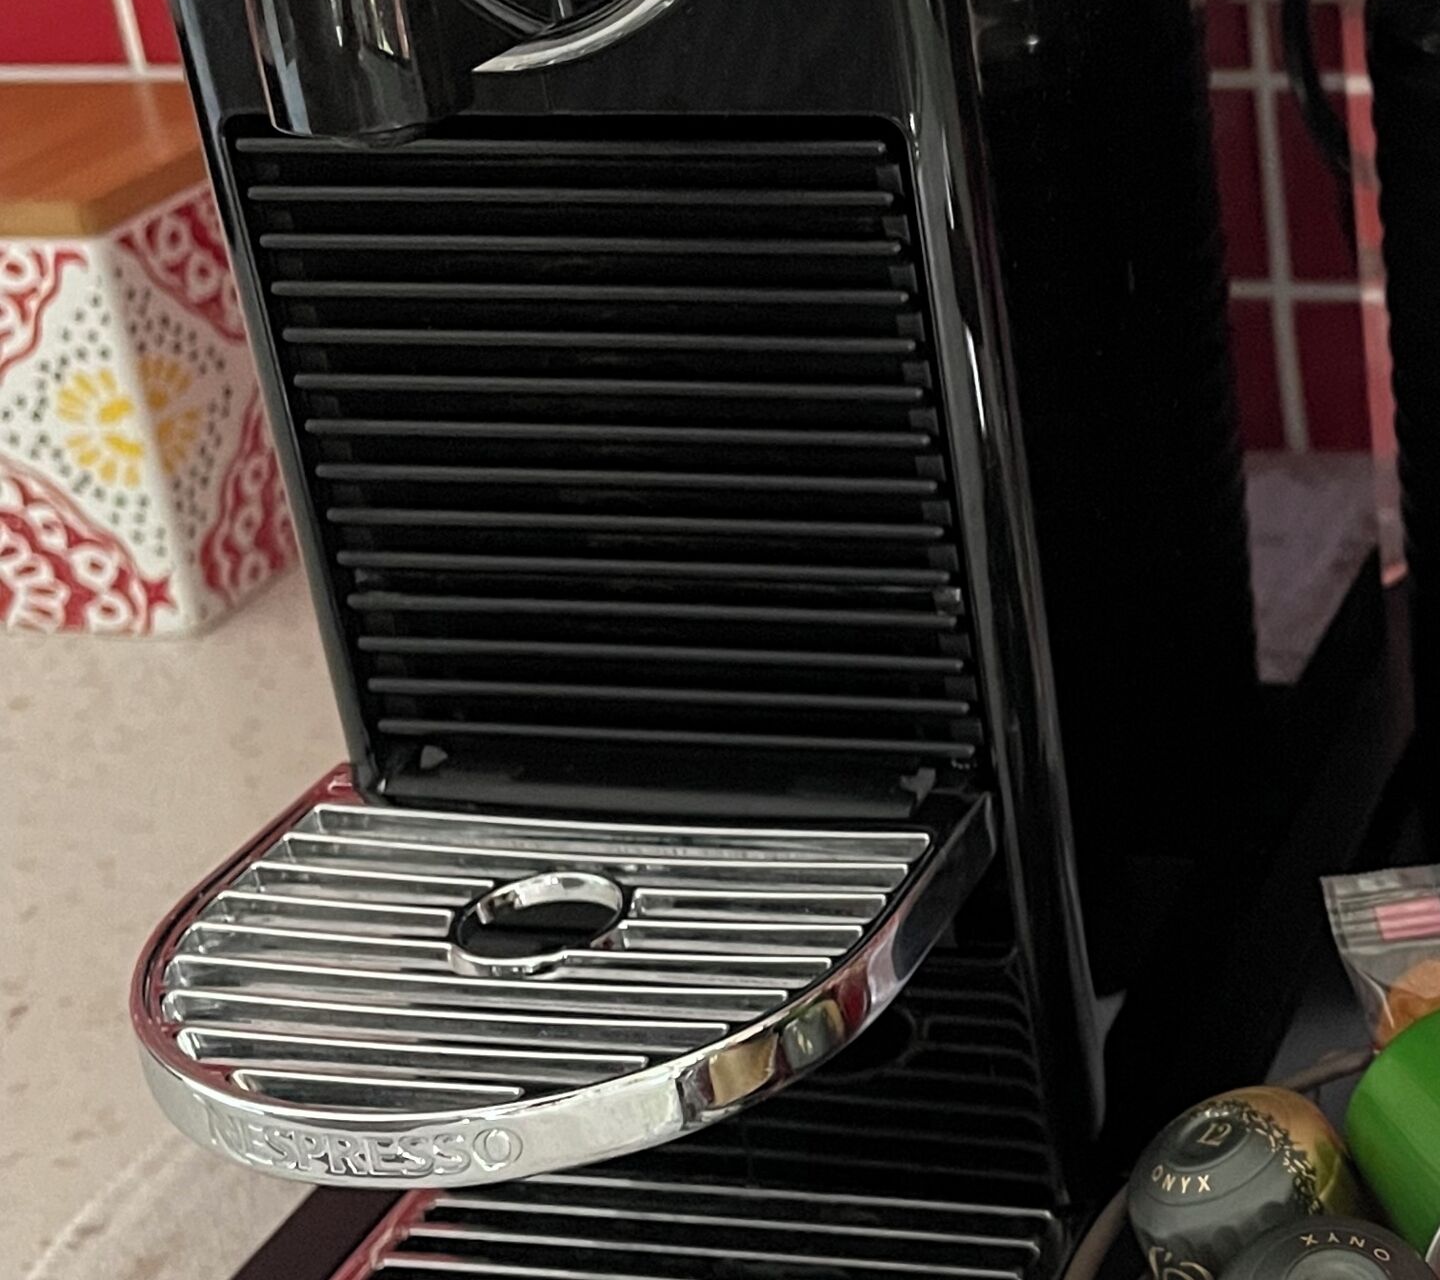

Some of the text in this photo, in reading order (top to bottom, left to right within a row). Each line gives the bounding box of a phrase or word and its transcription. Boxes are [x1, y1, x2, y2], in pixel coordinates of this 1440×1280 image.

[207, 1108, 523, 1176] NESPRESSO
[1197, 1122, 1232, 1146] 12
[1152, 1164, 1212, 1195] ONYX
[1300, 1231, 1390, 1262] ONYX
